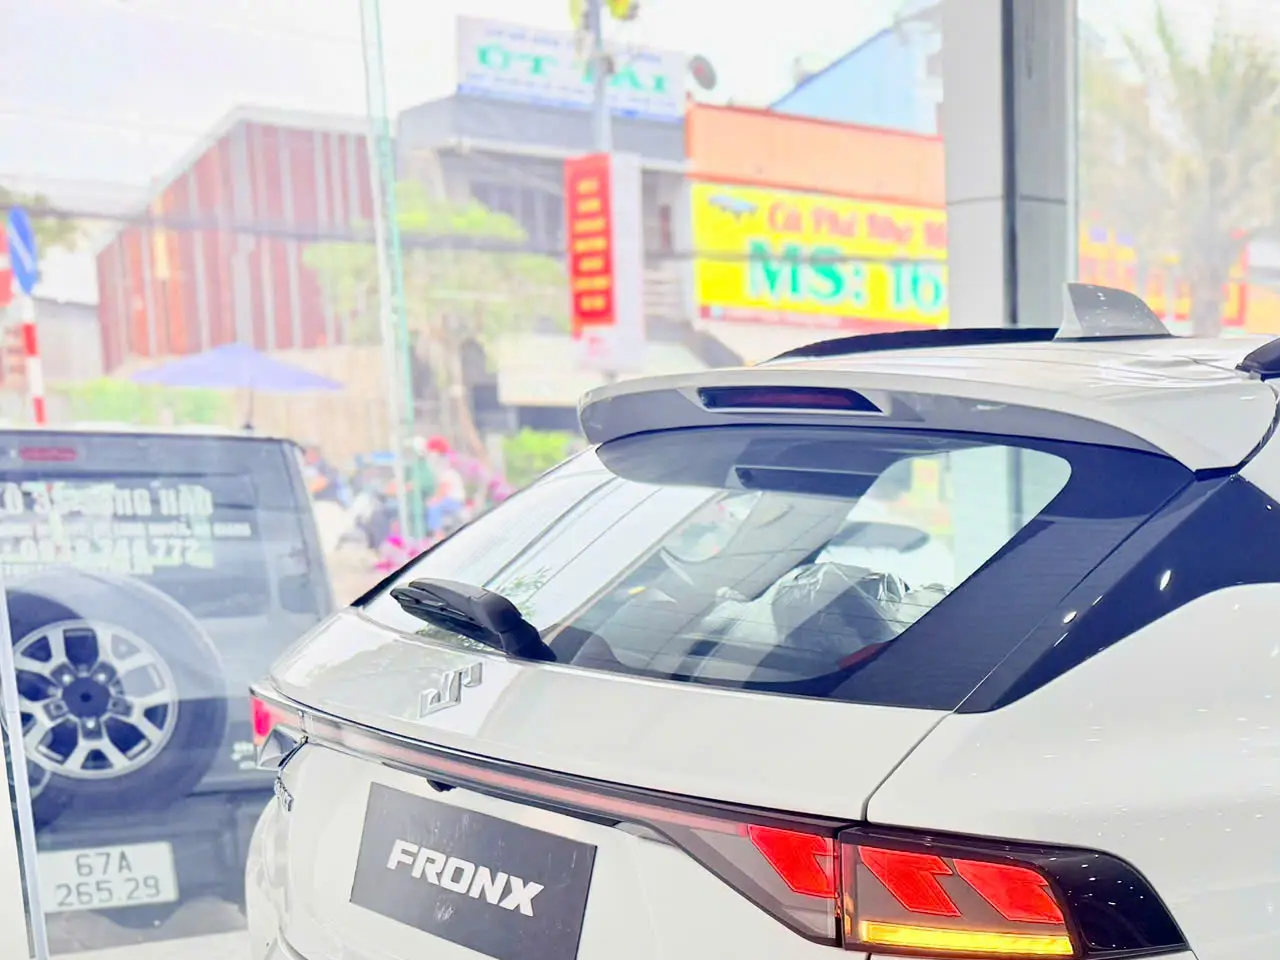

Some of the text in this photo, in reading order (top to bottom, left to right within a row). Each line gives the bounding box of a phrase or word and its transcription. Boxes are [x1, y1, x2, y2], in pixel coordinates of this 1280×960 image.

[747, 239, 866, 306] MS:
[75, 848, 133, 877] 67A
[386, 839, 544, 917] FRONX
[55, 876, 161, 907] 265.29
